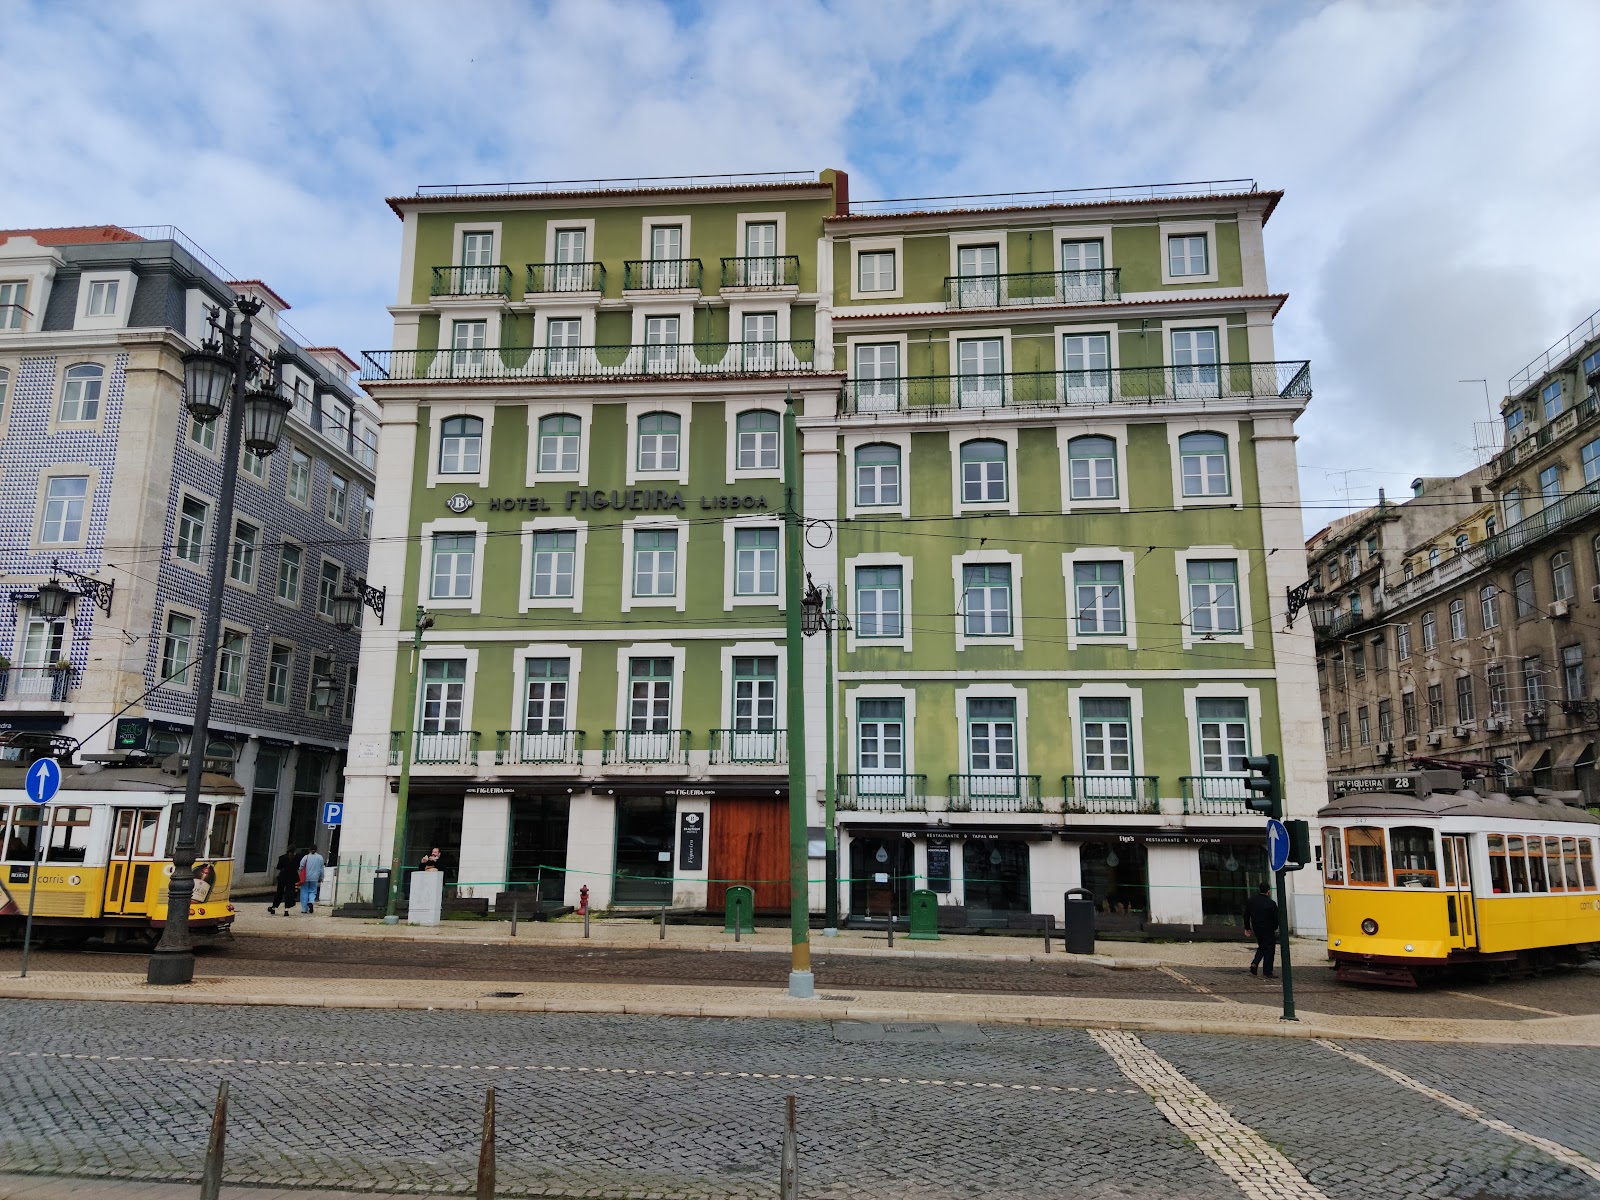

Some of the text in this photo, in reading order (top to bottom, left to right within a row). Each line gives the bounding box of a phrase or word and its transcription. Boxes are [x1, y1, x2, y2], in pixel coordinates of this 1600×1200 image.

[489, 489, 768, 511] HOTEL FIGUEIRA LISBOA
[1346, 780, 1383, 788] FIGUEIRA
[1395, 777, 1410, 788] 28
[327, 804, 340, 823] P
[37, 874, 64, 884] carris
